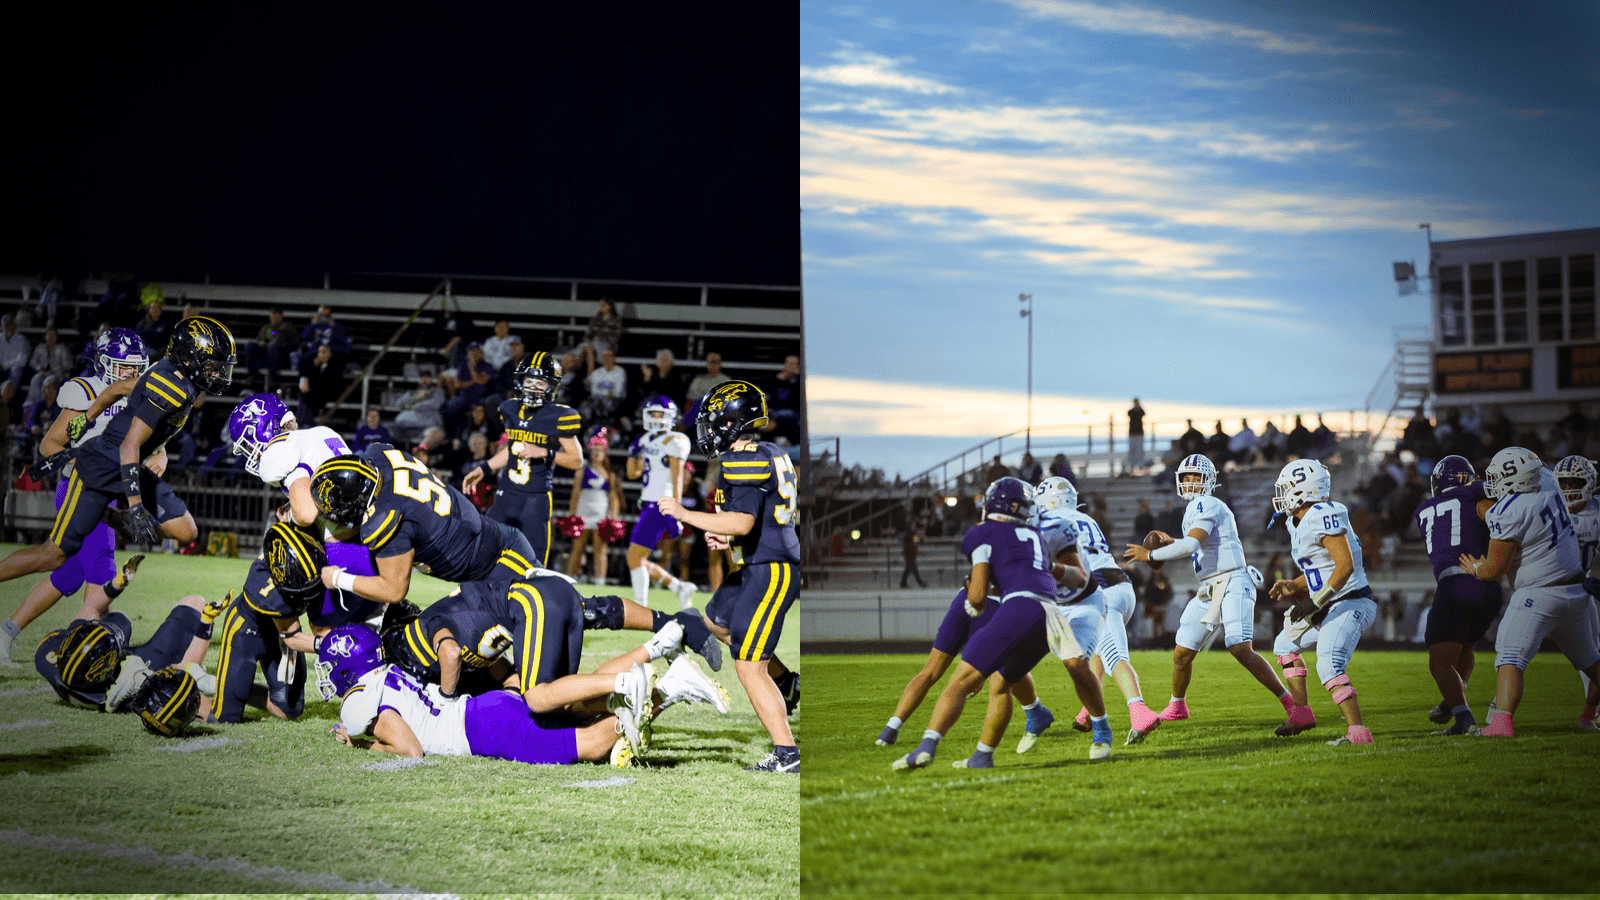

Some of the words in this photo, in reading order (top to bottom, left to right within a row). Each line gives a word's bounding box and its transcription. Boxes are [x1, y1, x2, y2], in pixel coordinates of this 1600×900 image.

[508, 440, 532, 486] 3
[1502, 459, 1518, 476] S
[1292, 467, 1307, 484] S
[773, 453, 798, 525] 5
[1196, 501, 1204, 514] 4
[1322, 513, 1340, 530] 66
[1418, 498, 1462, 555] 77
[1014, 527, 1043, 570] 7
[1524, 598, 1534, 609] S
[1352, 609, 1362, 620] S
